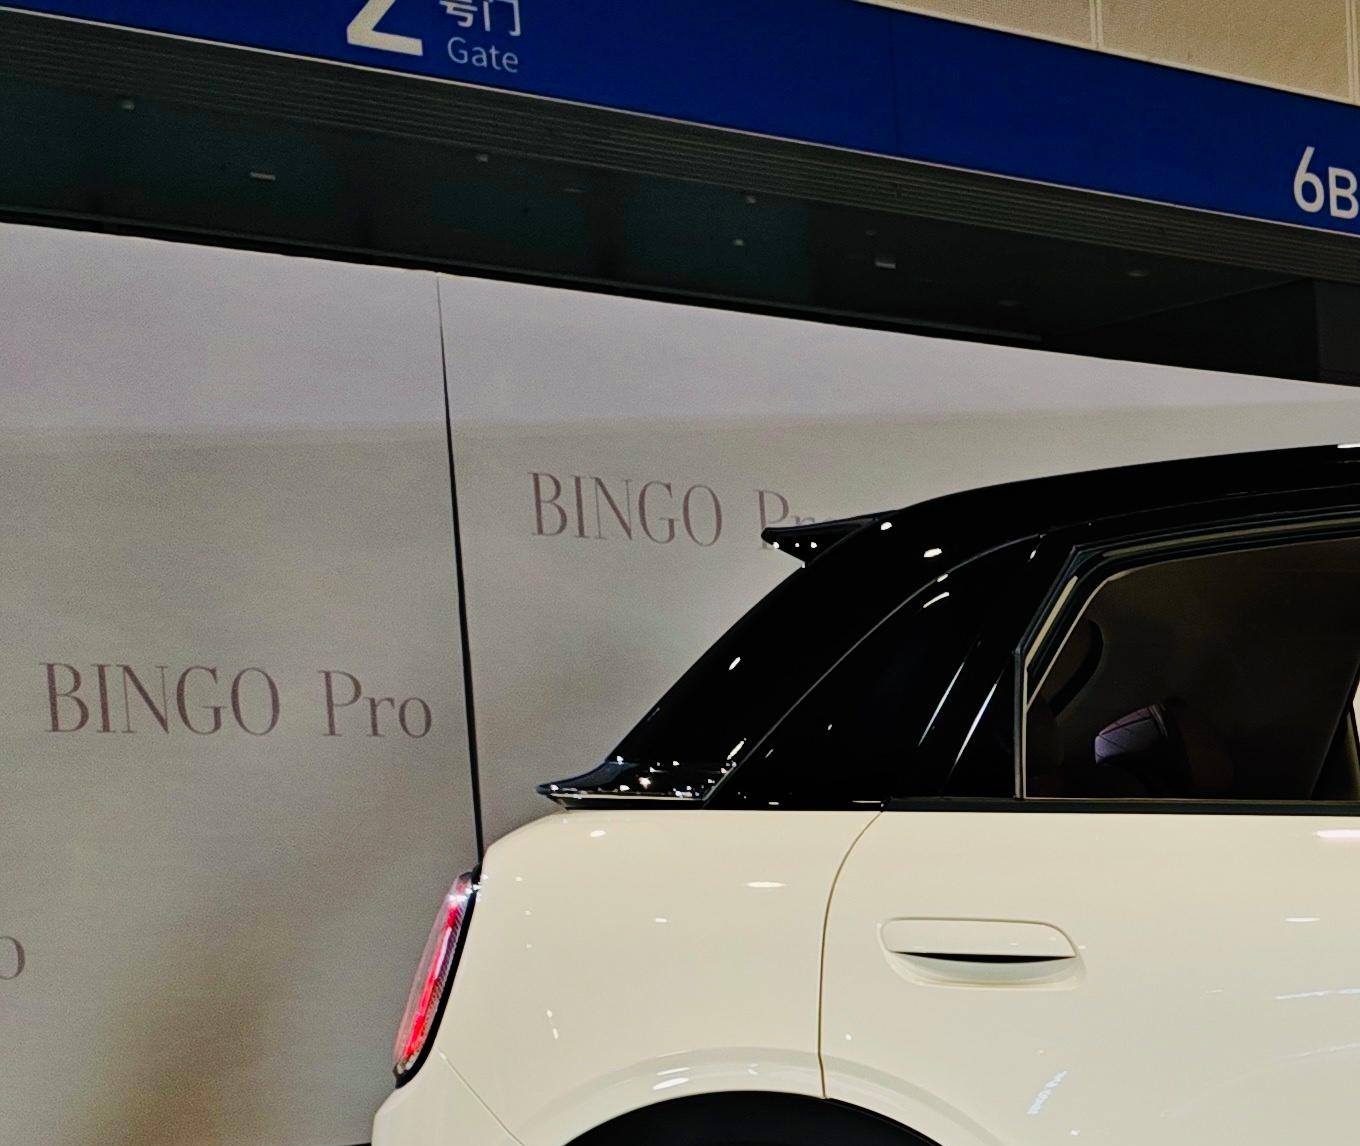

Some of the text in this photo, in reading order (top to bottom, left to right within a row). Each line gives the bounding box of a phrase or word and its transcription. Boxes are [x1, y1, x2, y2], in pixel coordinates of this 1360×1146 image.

[447, 36, 519, 73] Gate
[1293, 145, 1360, 219] 6B
[527, 471, 723, 547] BINGO
[39, 661, 433, 739] BINGO Pro
